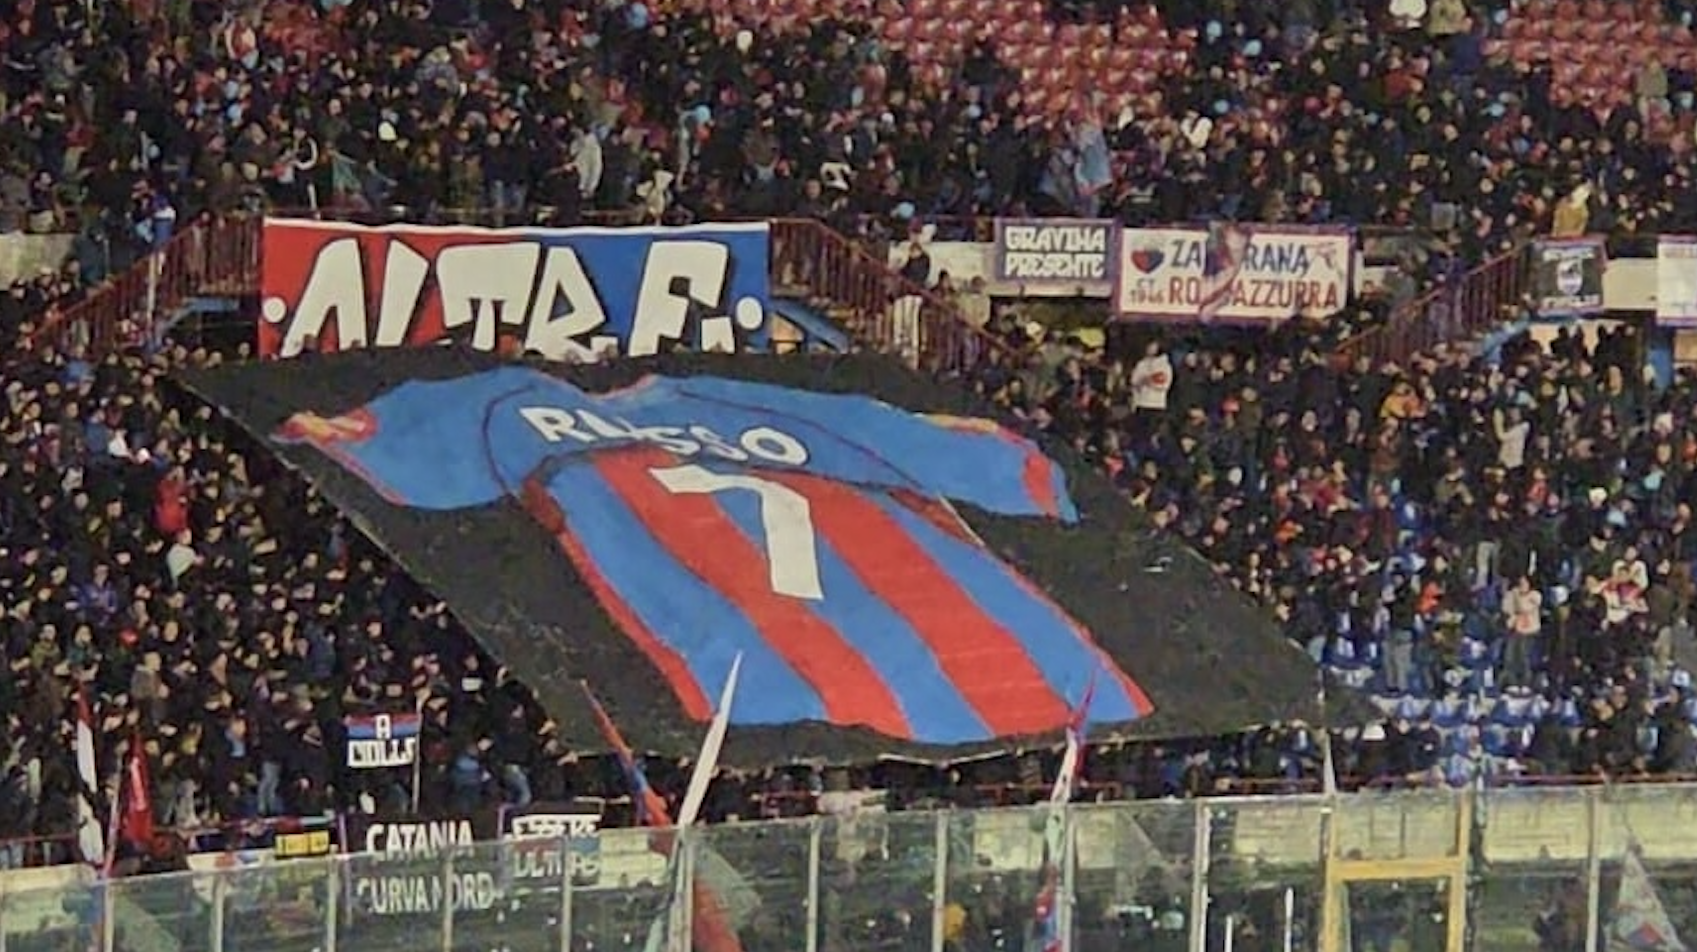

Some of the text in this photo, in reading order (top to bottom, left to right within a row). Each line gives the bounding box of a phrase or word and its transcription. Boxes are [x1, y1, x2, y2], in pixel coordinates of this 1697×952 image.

[1005, 226, 1105, 251] GRAVINA
[1005, 252, 1104, 277] PRESENTE
[1171, 239, 1309, 273] ZARANA
[1169, 276, 1338, 308] ROAZZURRA
[519, 407, 808, 465] RUSSO
[648, 464, 824, 600] 7
[376, 715, 391, 739] A
[366, 820, 475, 861] CATANIA
[513, 849, 600, 877] ULTAS
[357, 876, 431, 913] CURVA
